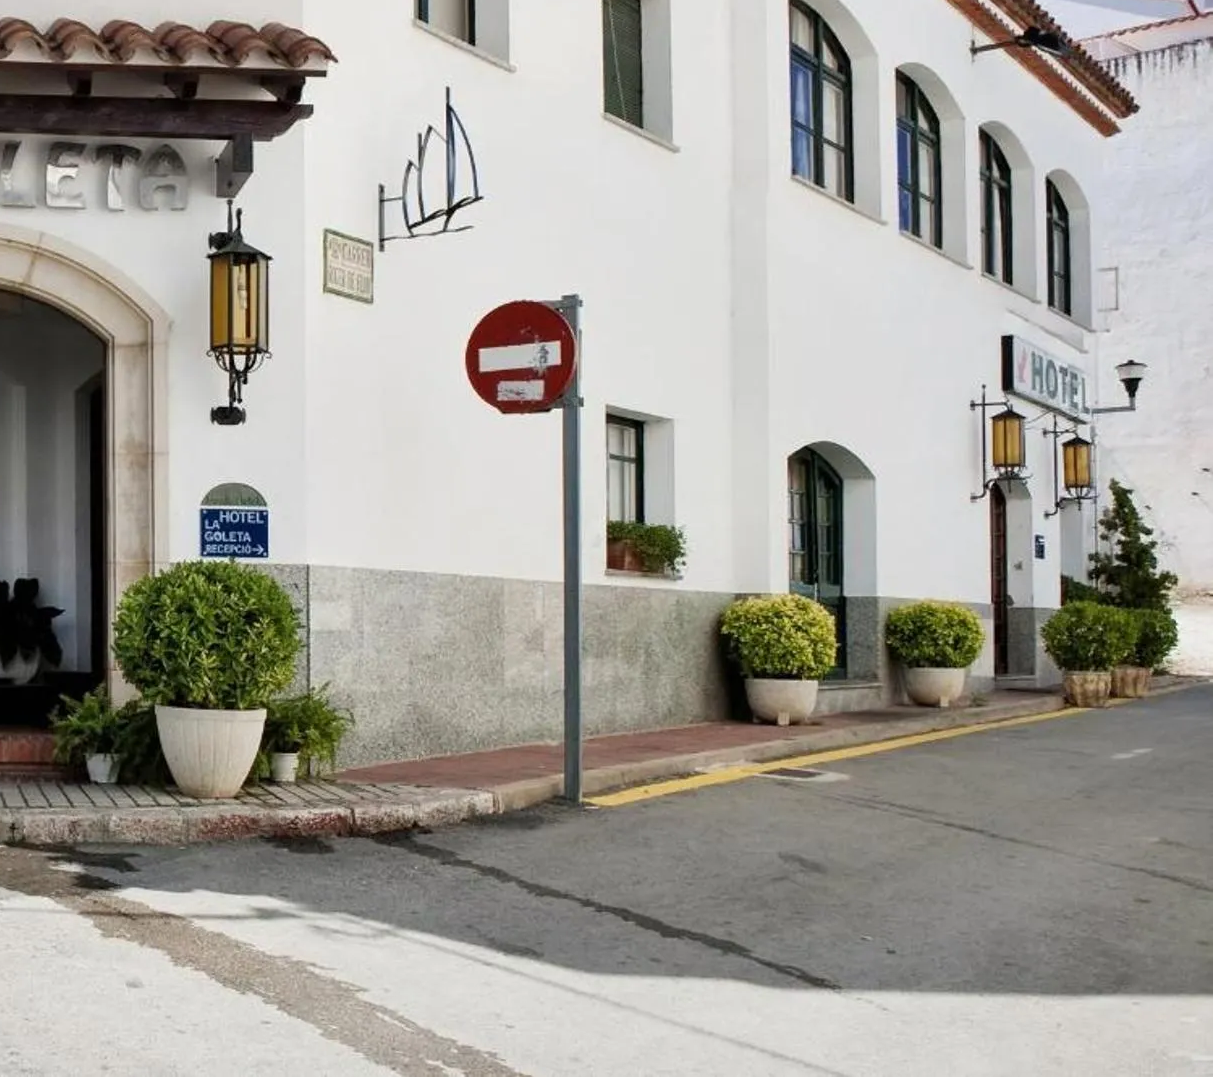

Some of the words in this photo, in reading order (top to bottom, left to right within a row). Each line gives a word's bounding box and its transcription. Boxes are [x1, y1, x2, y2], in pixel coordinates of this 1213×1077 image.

[1031, 350, 1090, 414] HOTEL
[219, 510, 264, 524] HOTEL
[204, 519, 220, 529] LA
[204, 531, 252, 542] GOLETA
